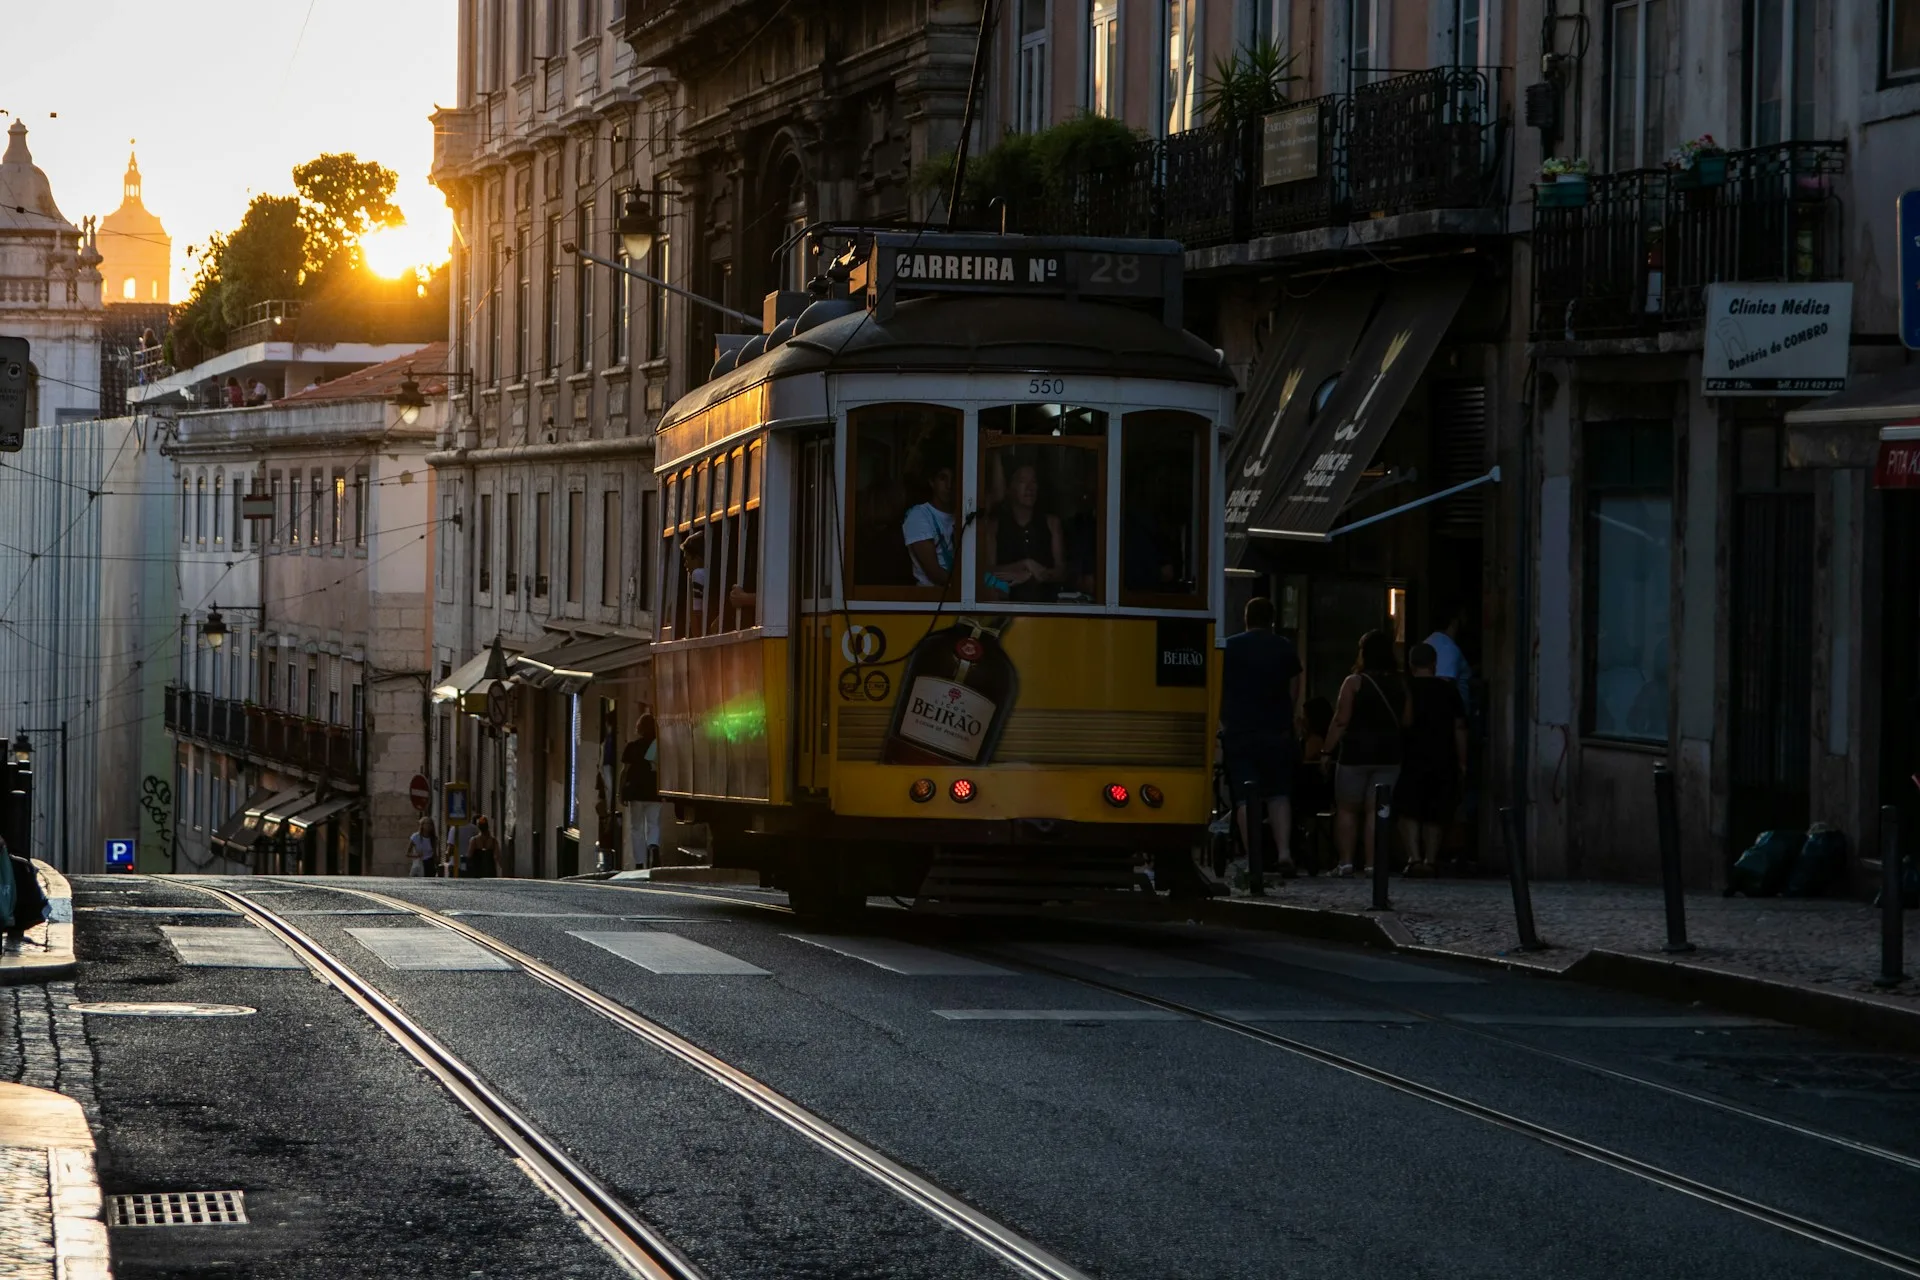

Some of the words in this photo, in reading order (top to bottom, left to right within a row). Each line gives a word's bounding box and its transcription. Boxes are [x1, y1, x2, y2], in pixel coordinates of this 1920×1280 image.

[896, 253, 1014, 281] CARREIRA
[1029, 258, 1057, 282] Nº
[1089, 252, 1140, 283] 28
[1729, 298, 1776, 315] Clínica
[1781, 298, 1830, 315] Médica
[1728, 348, 1767, 370] Dentária
[1770, 341, 1782, 354] do
[1784, 322, 1828, 349] COMBRO
[1029, 378, 1065, 395] 550
[1886, 449, 1909, 475] PITA
[1163, 650, 1203, 666] BEIRÃO
[910, 697, 981, 736] BEIRÃO
[112, 842, 127, 861] P
